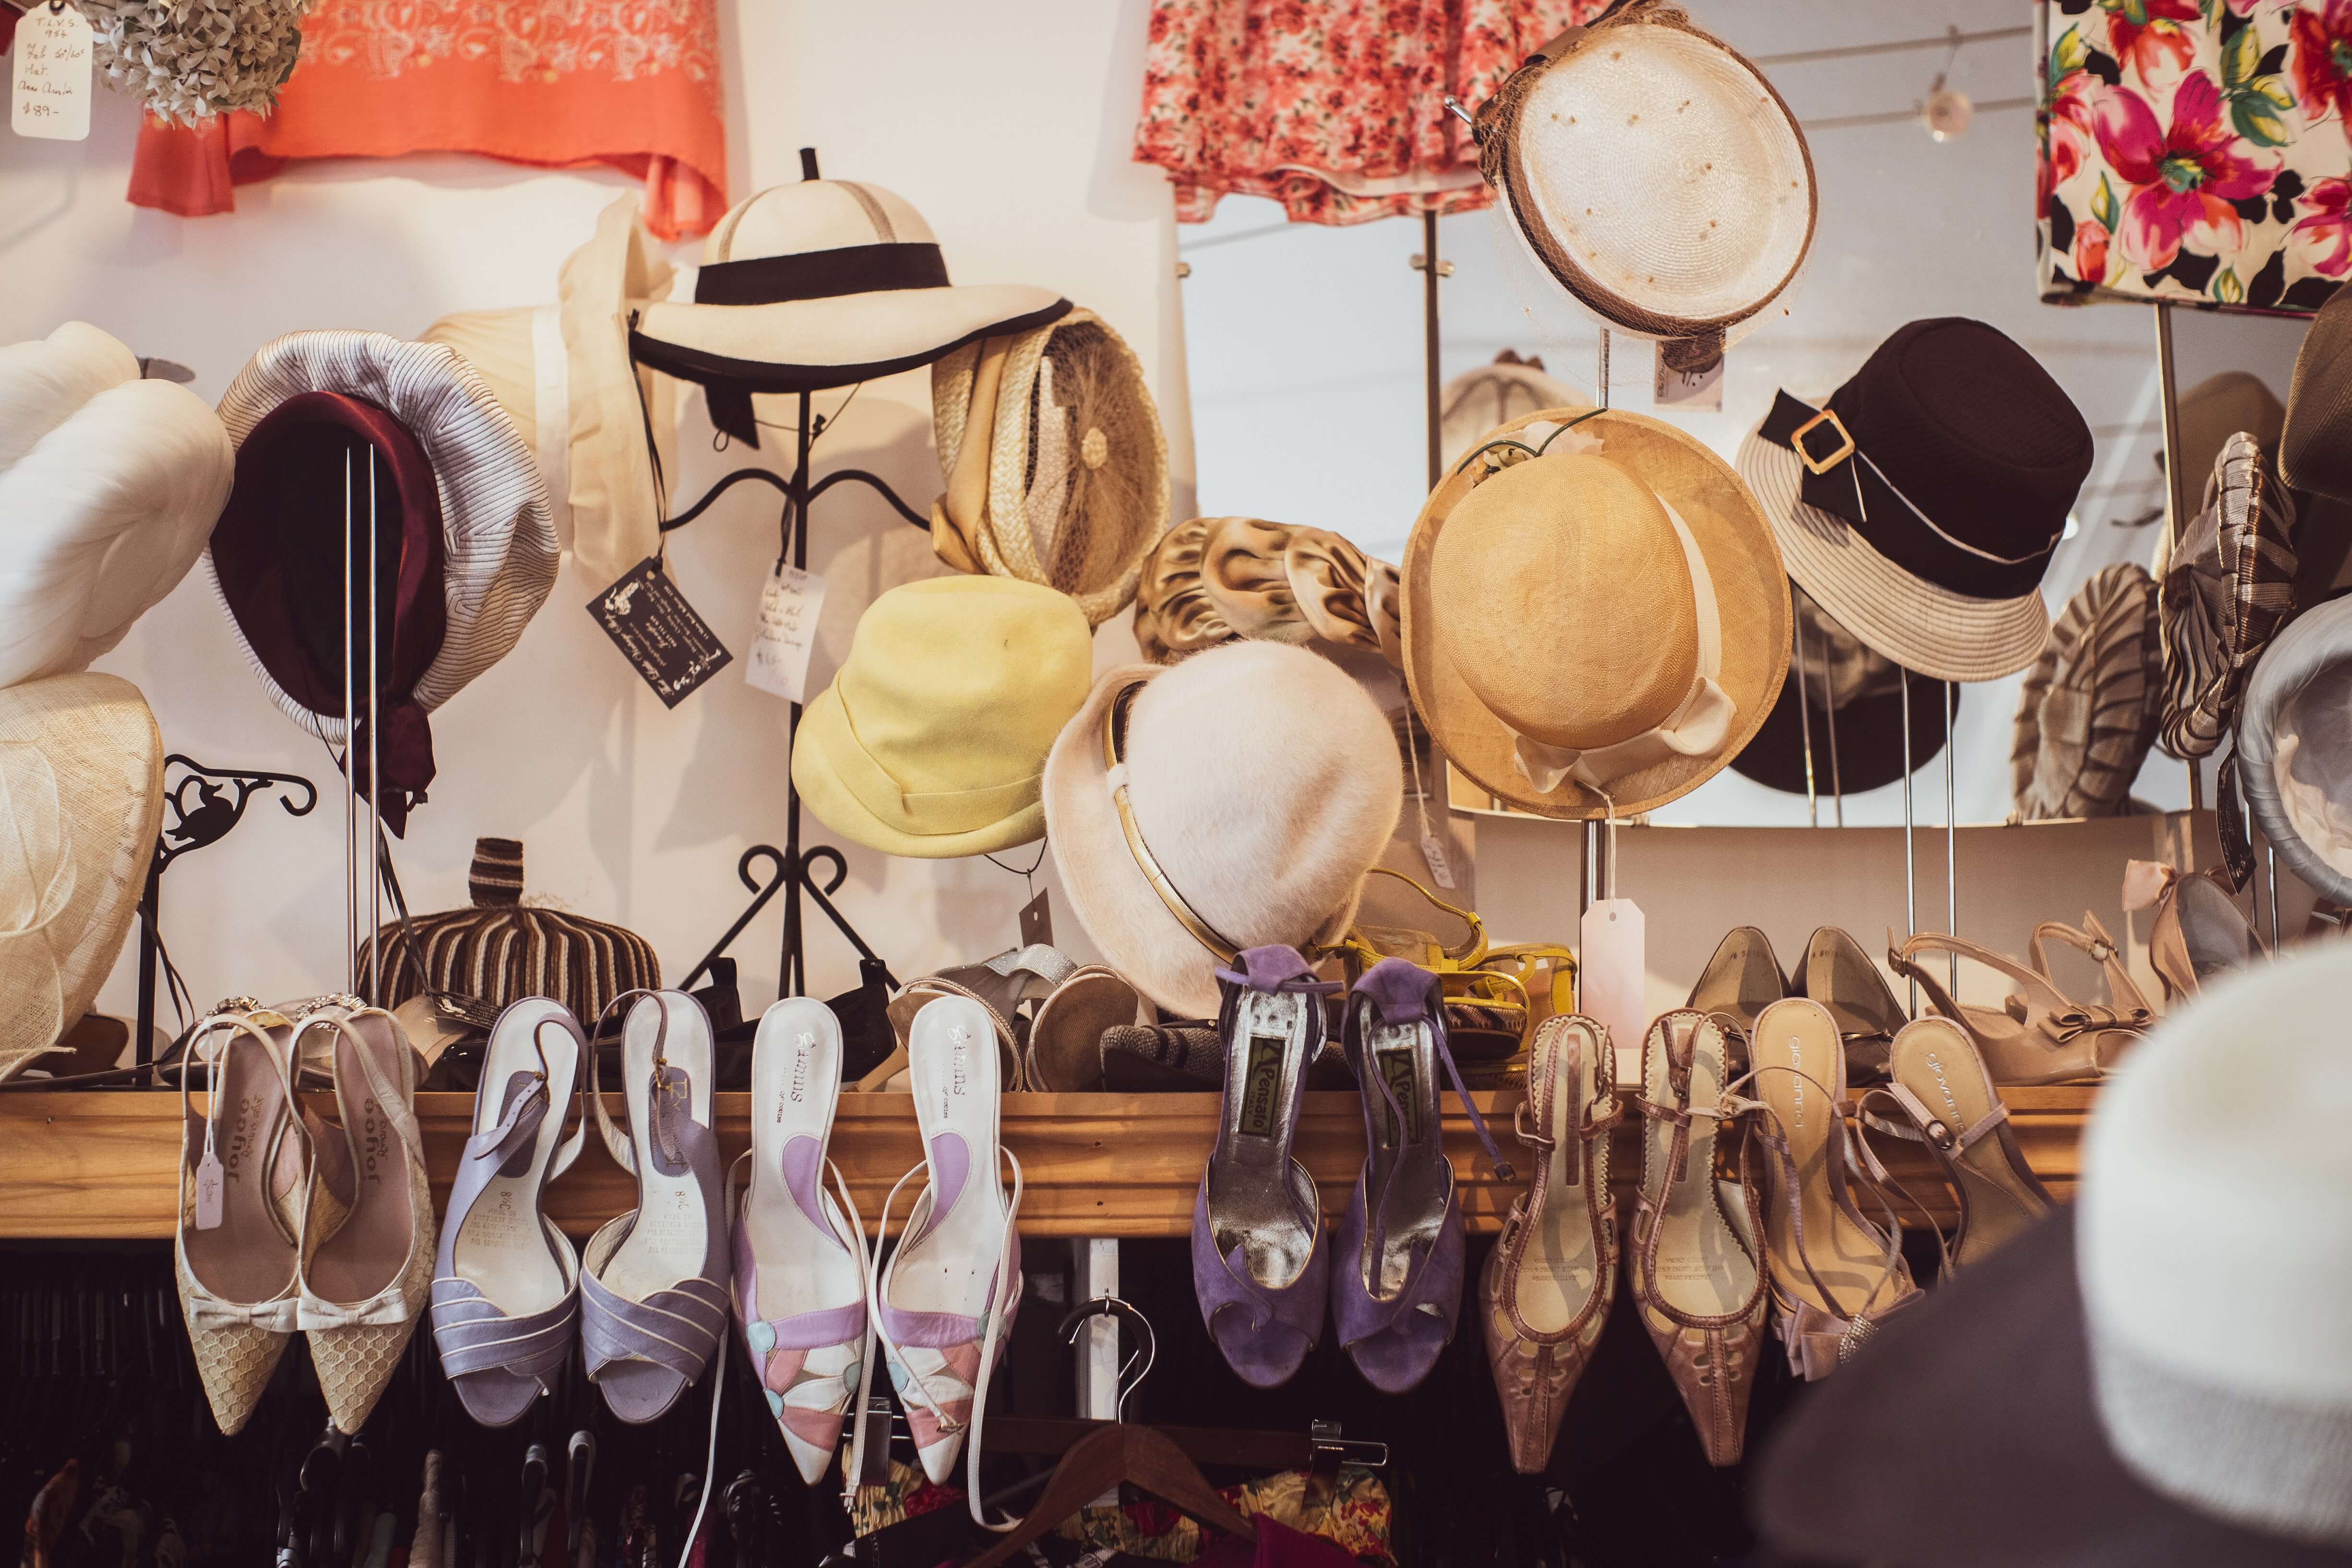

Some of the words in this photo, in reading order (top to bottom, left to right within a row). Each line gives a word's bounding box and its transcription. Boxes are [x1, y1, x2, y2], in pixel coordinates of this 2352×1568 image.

[618, 631, 646, 661] Vintage
[1245, 1091, 1256, 1116] ITALY
[1252, 1066, 1276, 1129] Pensato
